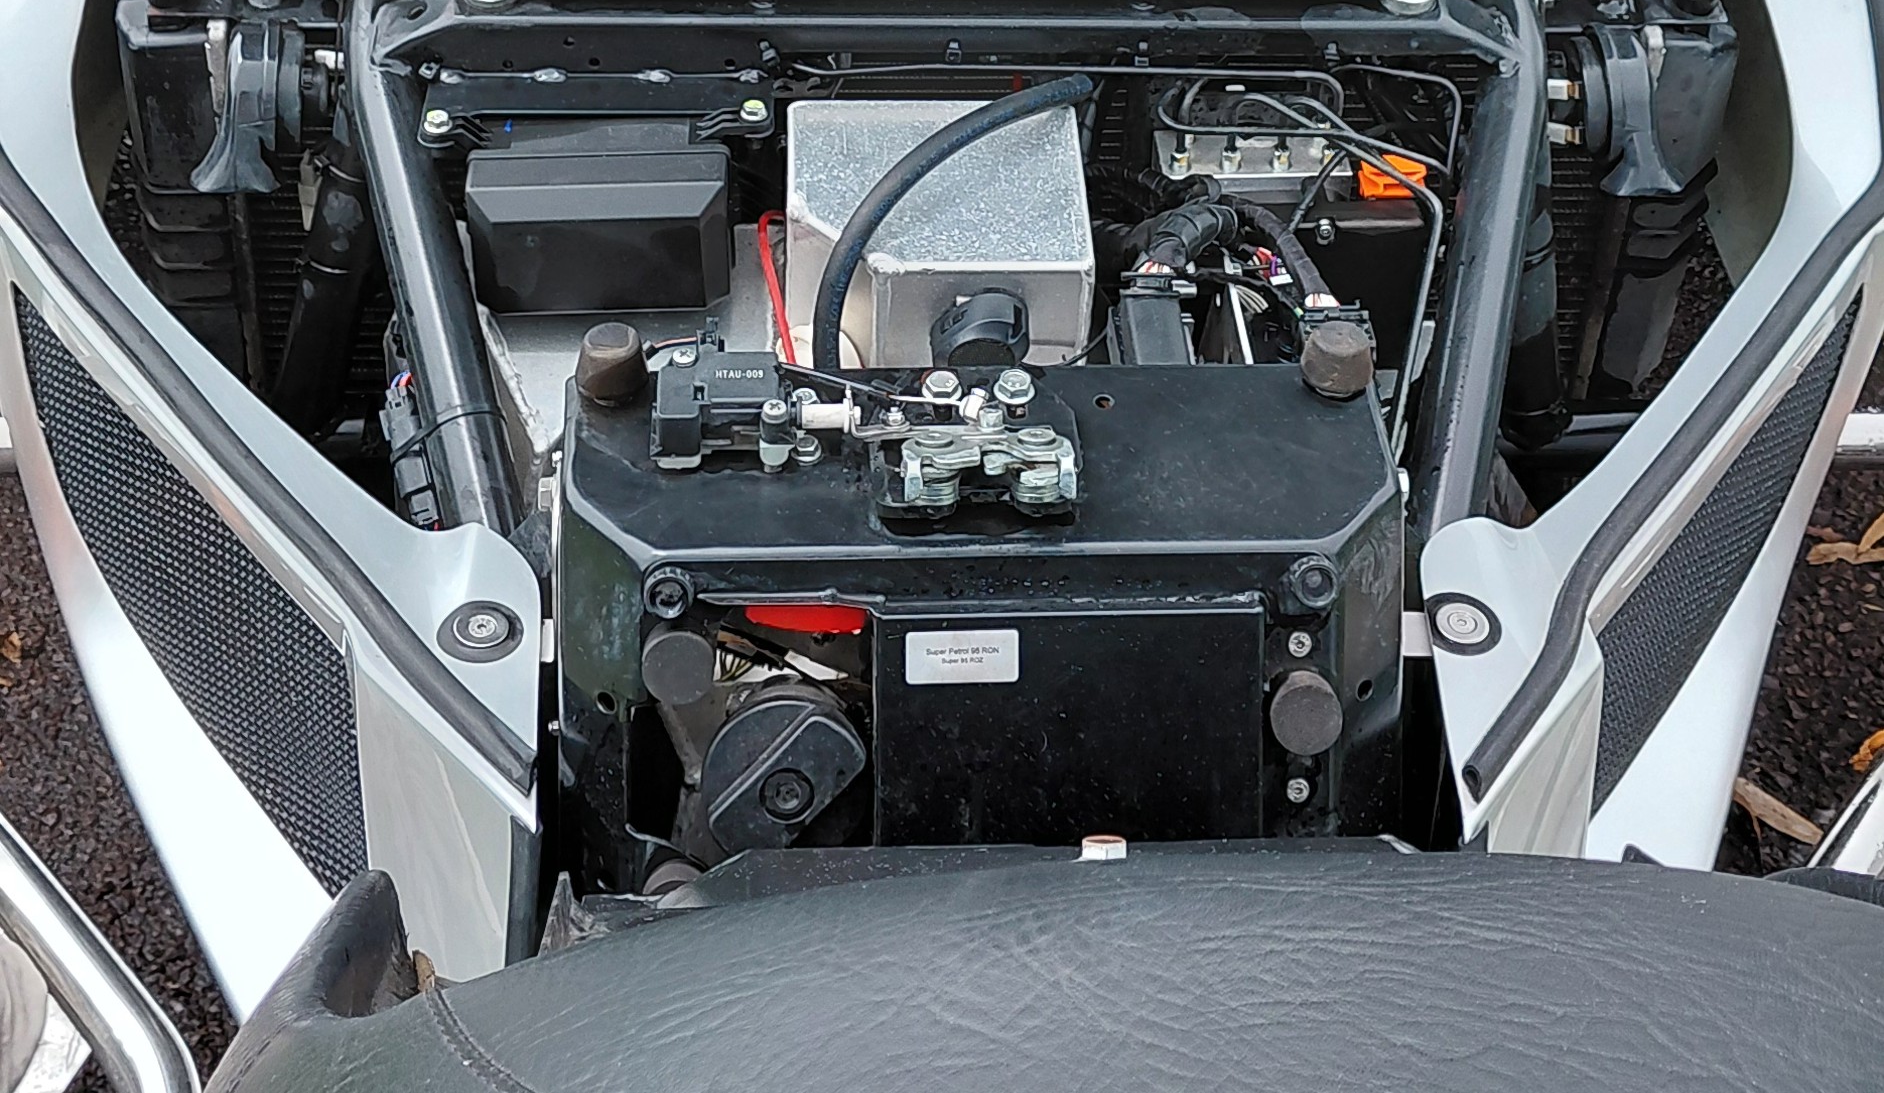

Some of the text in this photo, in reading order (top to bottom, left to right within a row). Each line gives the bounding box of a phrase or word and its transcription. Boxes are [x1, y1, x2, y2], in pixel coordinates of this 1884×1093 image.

[715, 369, 764, 379] HTAU-009
[926, 648, 946, 656] Super
[949, 647, 969, 655] Petrol
[981, 646, 999, 654] RON
[941, 657, 959, 665] Super
